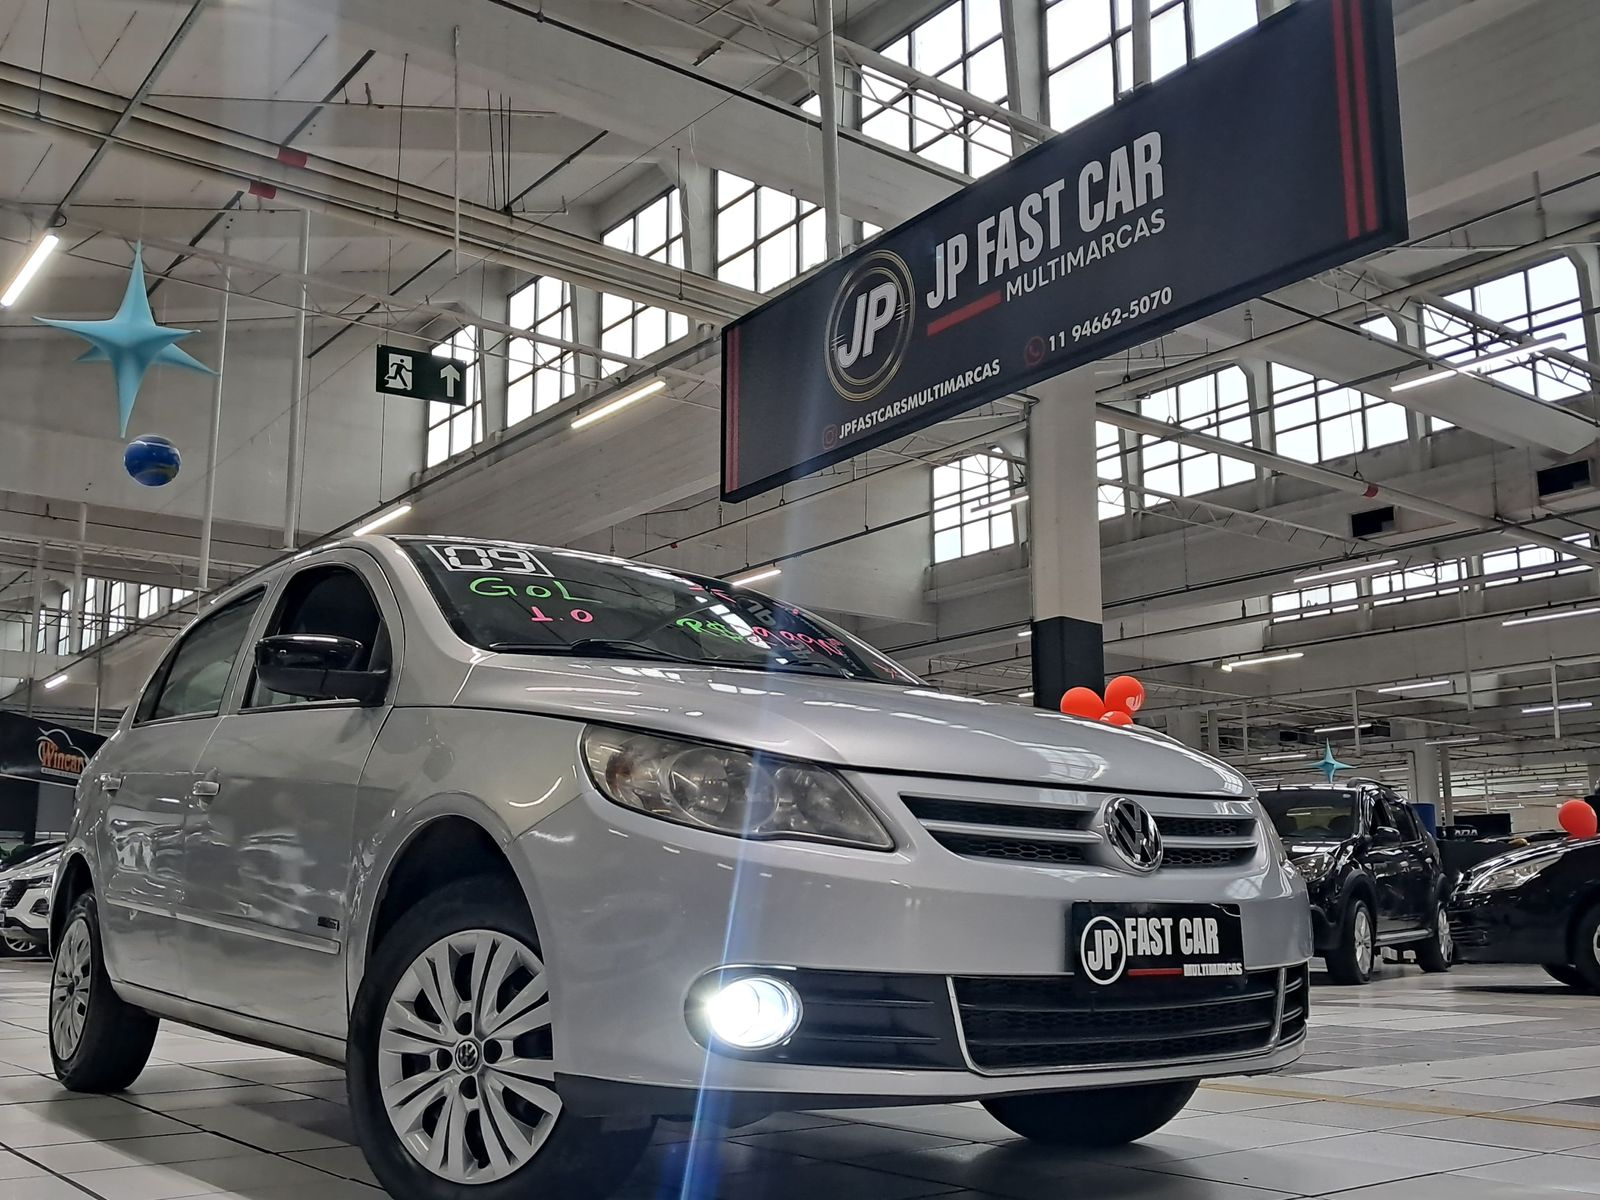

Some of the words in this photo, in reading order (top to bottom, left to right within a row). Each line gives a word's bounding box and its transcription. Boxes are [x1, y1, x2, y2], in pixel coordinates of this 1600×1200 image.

[926, 233, 968, 309] JP
[977, 178, 1065, 285] FAST
[1079, 131, 1164, 233] CAR
[1006, 208, 1166, 302] MULTIMARCAS
[837, 280, 898, 370] JP
[1048, 329, 1066, 352] 11
[1071, 286, 1174, 343] 94662-5070
[838, 358, 1000, 440] JPFASTCARSMULTIMARCAS
[444, 546, 536, 573] 09
[1087, 929, 1119, 971] JP
[1124, 917, 1173, 956] FAST
[1179, 917, 1220, 955] CAR
[1183, 962, 1243, 977] MULTIMARCAS
